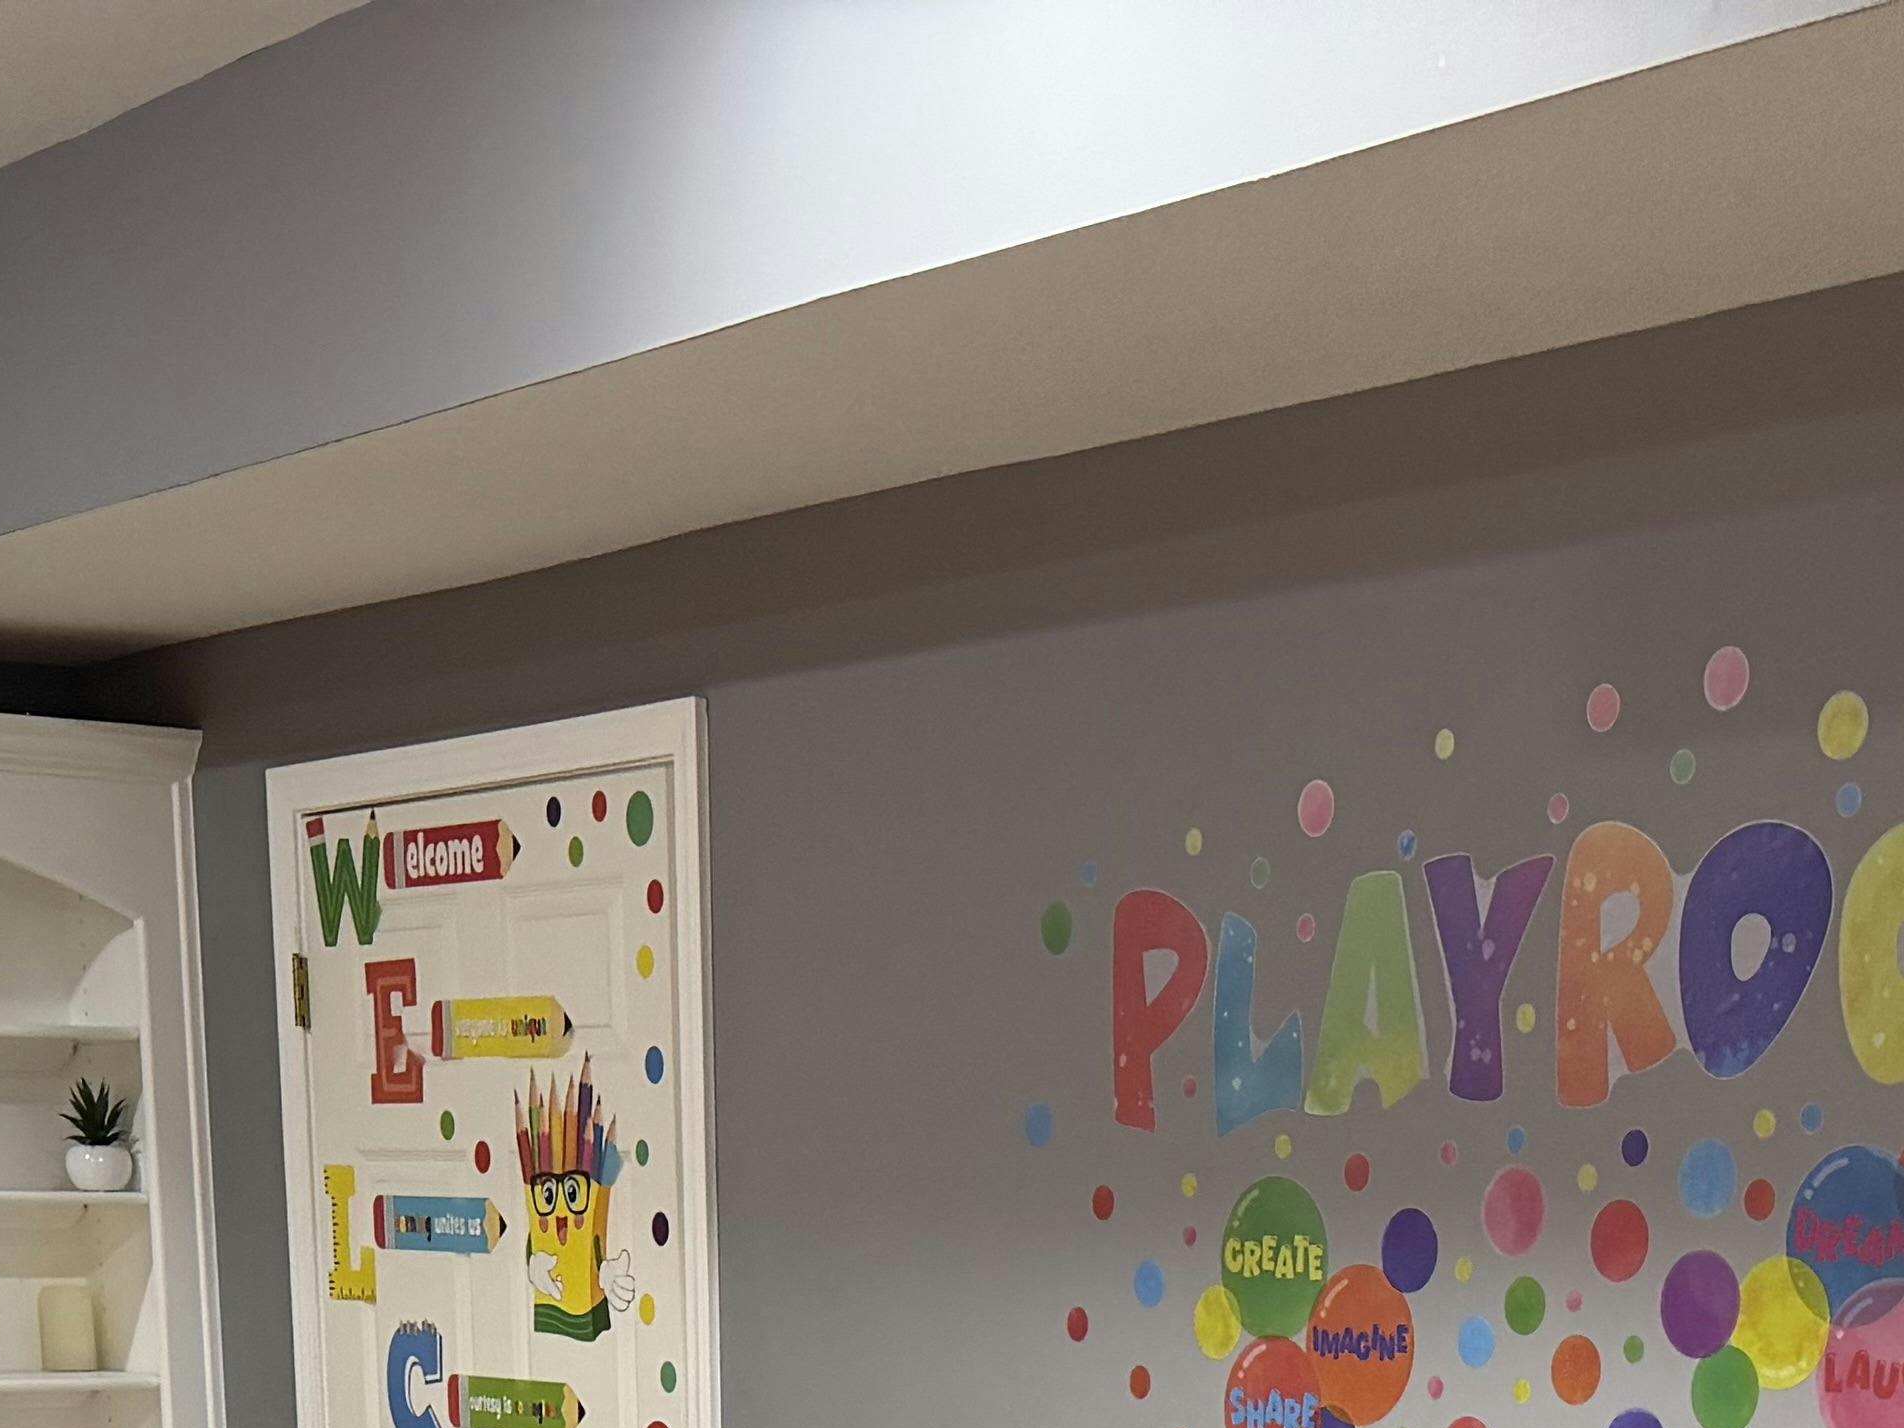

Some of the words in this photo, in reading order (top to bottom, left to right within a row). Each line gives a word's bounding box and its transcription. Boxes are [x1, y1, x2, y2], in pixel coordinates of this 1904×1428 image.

[406, 831, 485, 880] elcome
[1224, 1234, 1324, 1281] CREATE
[1312, 1323, 1410, 1362] IMAGINE
